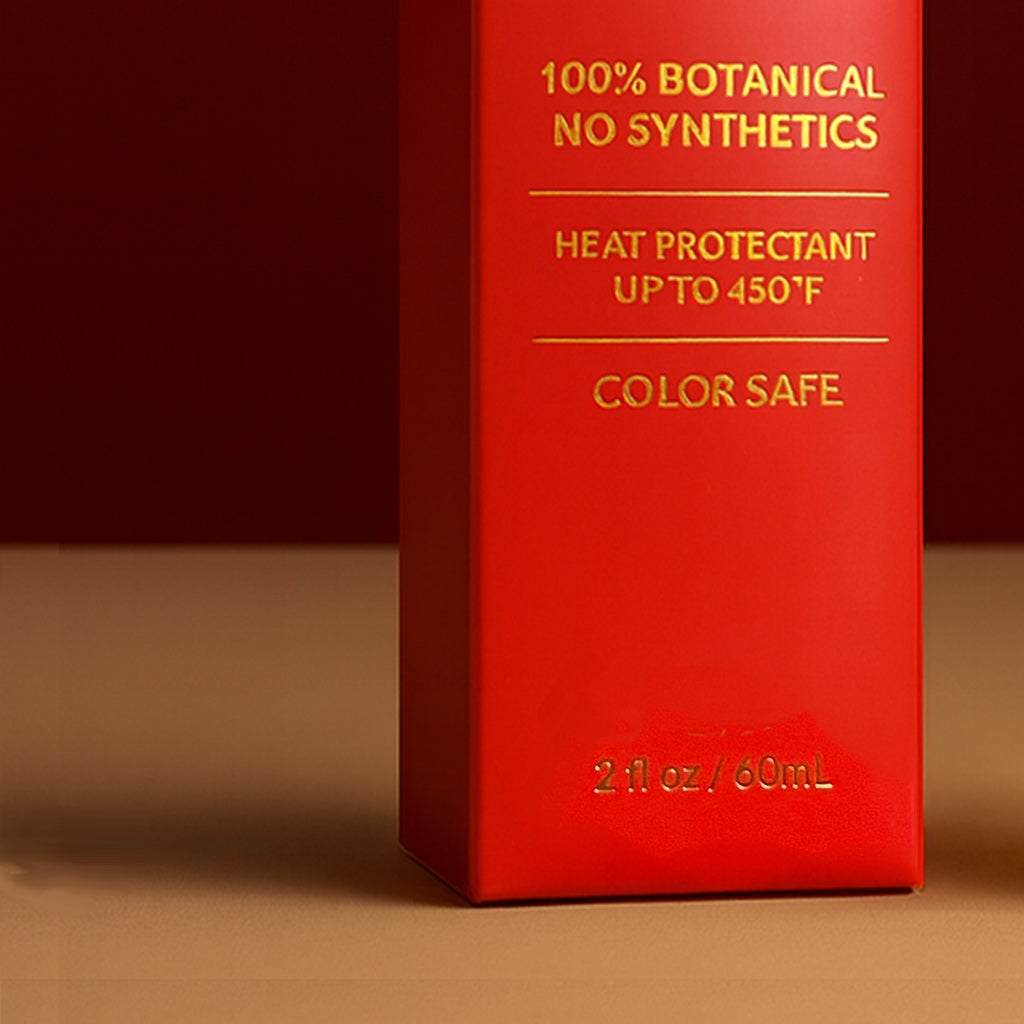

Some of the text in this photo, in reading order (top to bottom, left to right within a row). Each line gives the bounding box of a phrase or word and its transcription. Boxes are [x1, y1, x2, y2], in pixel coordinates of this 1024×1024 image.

[541, 61, 885, 99] 100% BOTANICAL
[554, 112, 878, 150] NO SYNTHETICS
[555, 230, 876, 261] HEAT PROTECTANT
[614, 275, 664, 304] UP
[668, 276, 719, 305] TO
[593, 374, 844, 408] COLOR SAFE
[594, 753, 833, 793] 2 fl oz / 60mL
